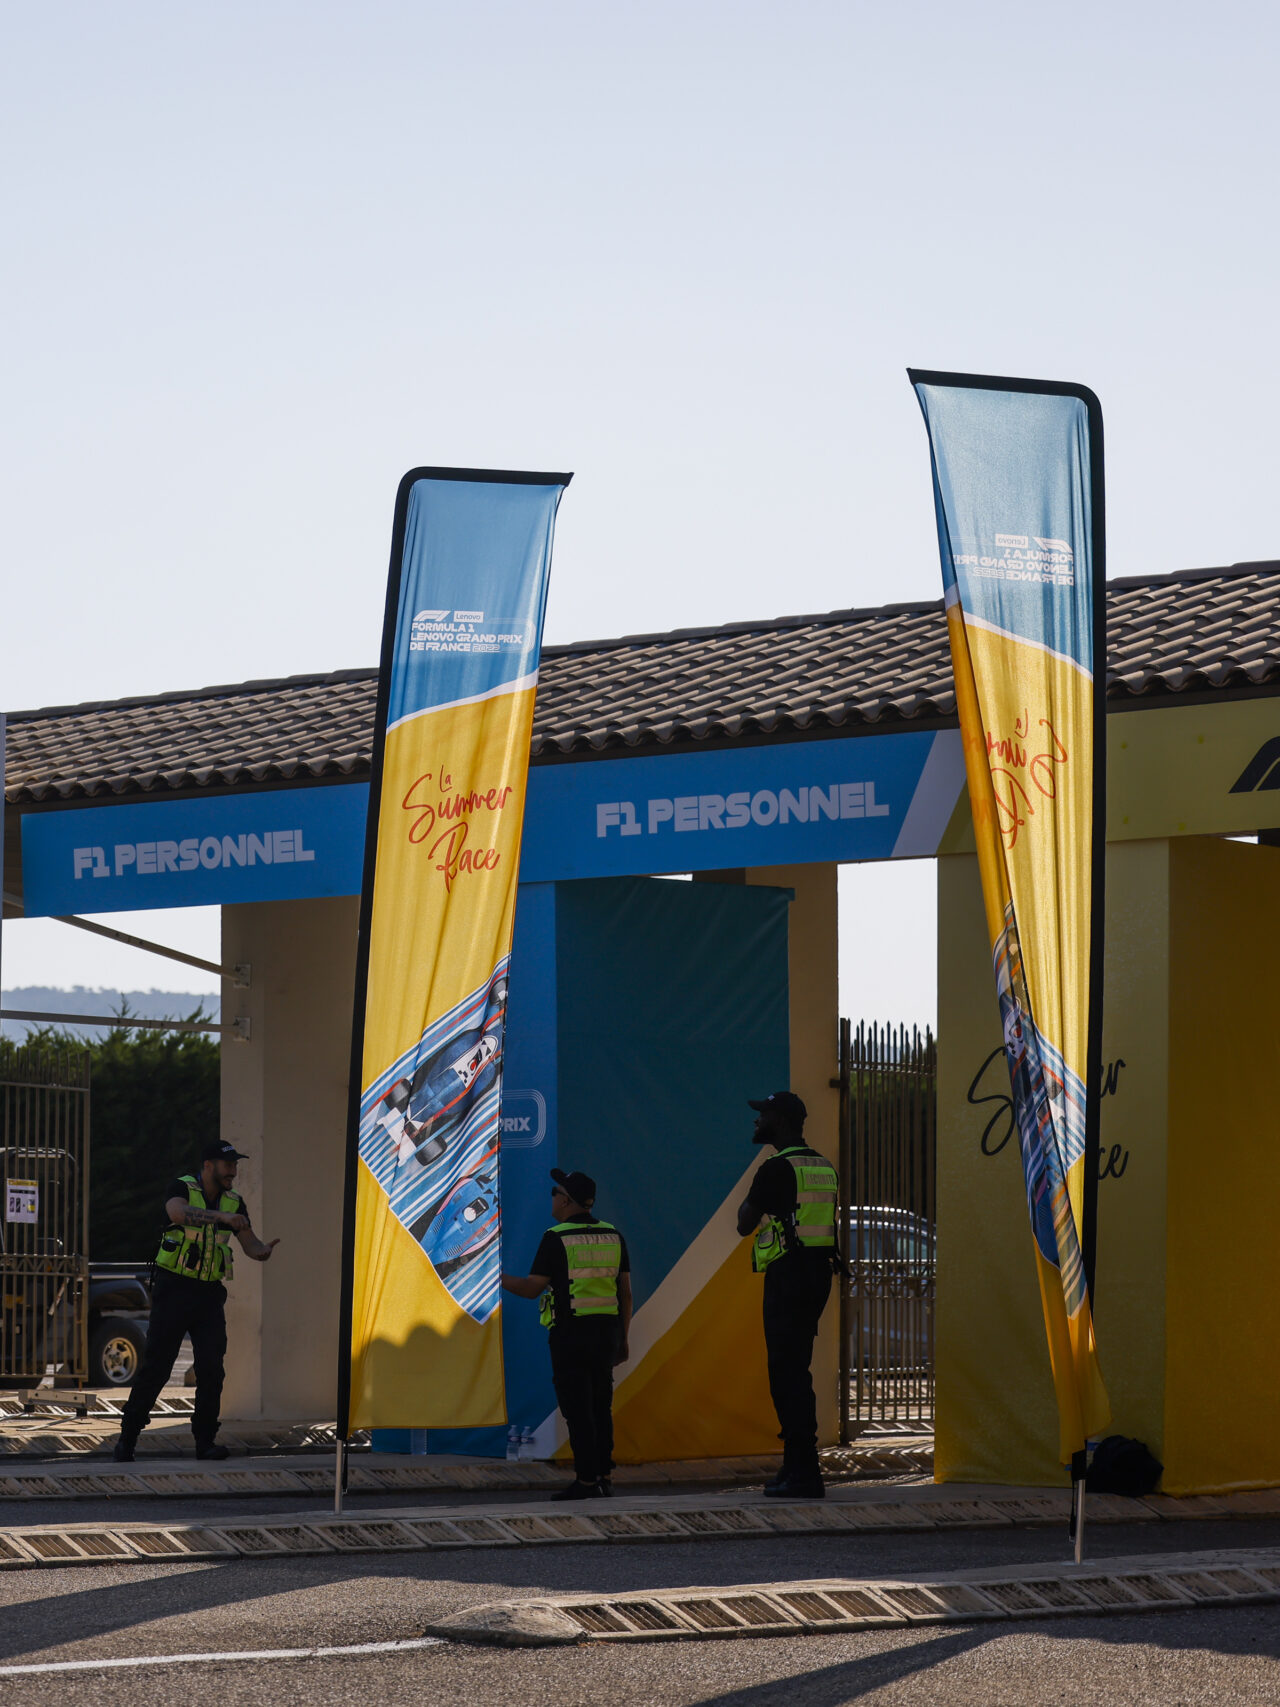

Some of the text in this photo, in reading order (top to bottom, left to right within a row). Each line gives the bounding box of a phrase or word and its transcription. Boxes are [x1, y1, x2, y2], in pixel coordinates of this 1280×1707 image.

[411, 622, 475, 633] FORMULA 1
[456, 613, 481, 621] Lenovo
[409, 642, 424, 651] DE
[426, 642, 471, 652] FRANCE
[411, 632, 523, 644] LENOVO GRAND PRIX
[402, 773, 513, 844] Summer
[596, 781, 890, 838] F1 PERSONNEL
[73, 829, 316, 879] F1 PERSONNEL
[427, 821, 501, 894] Race
